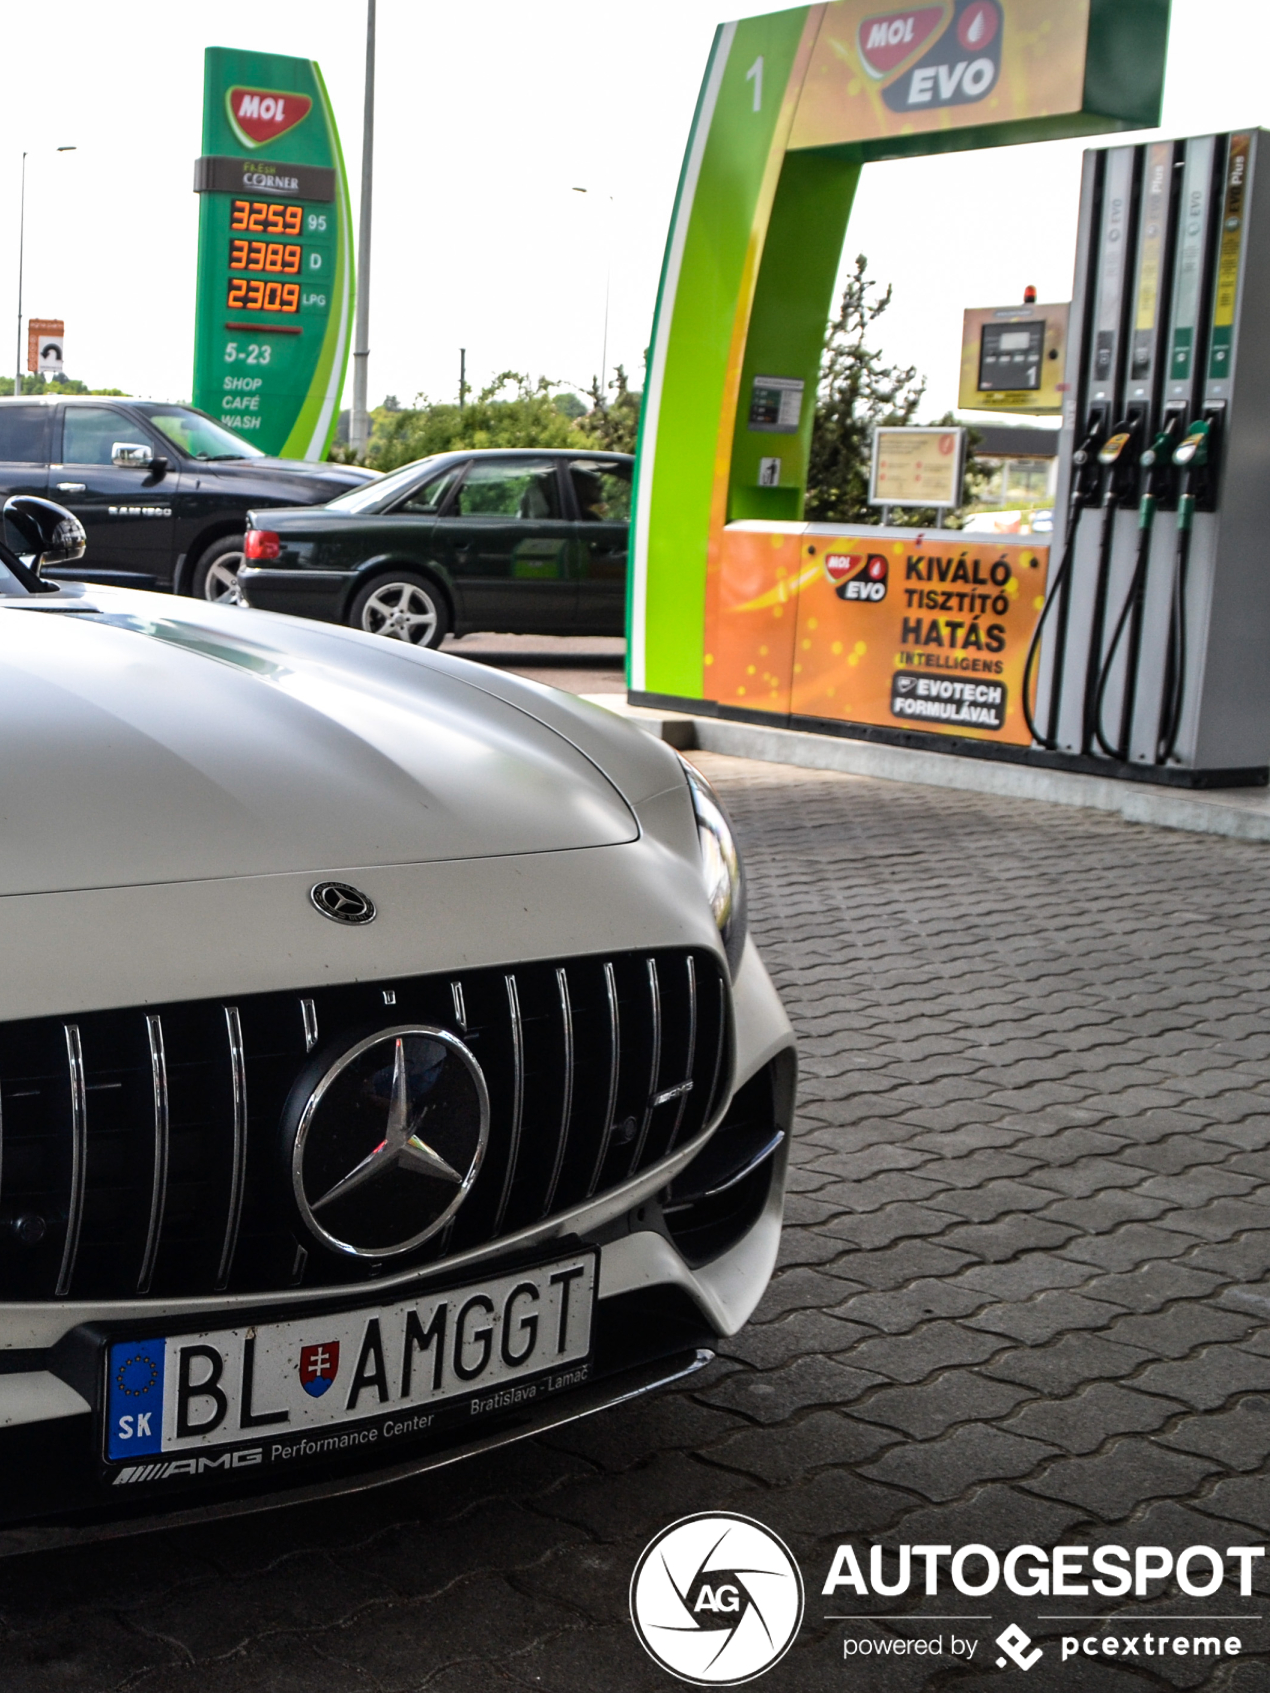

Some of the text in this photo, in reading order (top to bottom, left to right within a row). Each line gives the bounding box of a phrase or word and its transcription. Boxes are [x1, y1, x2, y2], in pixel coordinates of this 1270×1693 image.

[866, 16, 915, 50] MOL
[746, 55, 764, 113] 1
[907, 57, 995, 104] EVO
[238, 94, 286, 122] MOL
[243, 172, 299, 190] CORNER
[1151, 165, 1165, 194] Plus
[1231, 155, 1245, 186] Plus
[1111, 198, 1122, 223] EVO
[1190, 190, 1202, 217] EVO
[307, 214, 327, 231] 95
[310, 252, 323, 269] D
[302, 293, 327, 306] LPG
[224, 342, 272, 365] 5-23
[223, 376, 263, 391] SHOP
[222, 394, 261, 411] CAFÉ
[221, 415, 262, 429] WASH
[827, 555, 851, 569] MOL
[905, 551, 1012, 587] KIVÁLÓ
[845, 580, 886, 601] EVO
[904, 587, 1010, 616] TISZTÍTÓ
[901, 614, 1007, 653] HATÁS
[899, 651, 1004, 675] INTELLIGENS
[916, 678, 1002, 704] EVOTECH
[893, 697, 1000, 726] FORMULÁVAL
[176, 1266, 584, 1438] BL AMGGT
[470, 1386, 537, 1415] Bratislava
[118, 1412, 152, 1439] SK
[271, 1426, 378, 1462] Performance
[383, 1412, 435, 1438] Center
